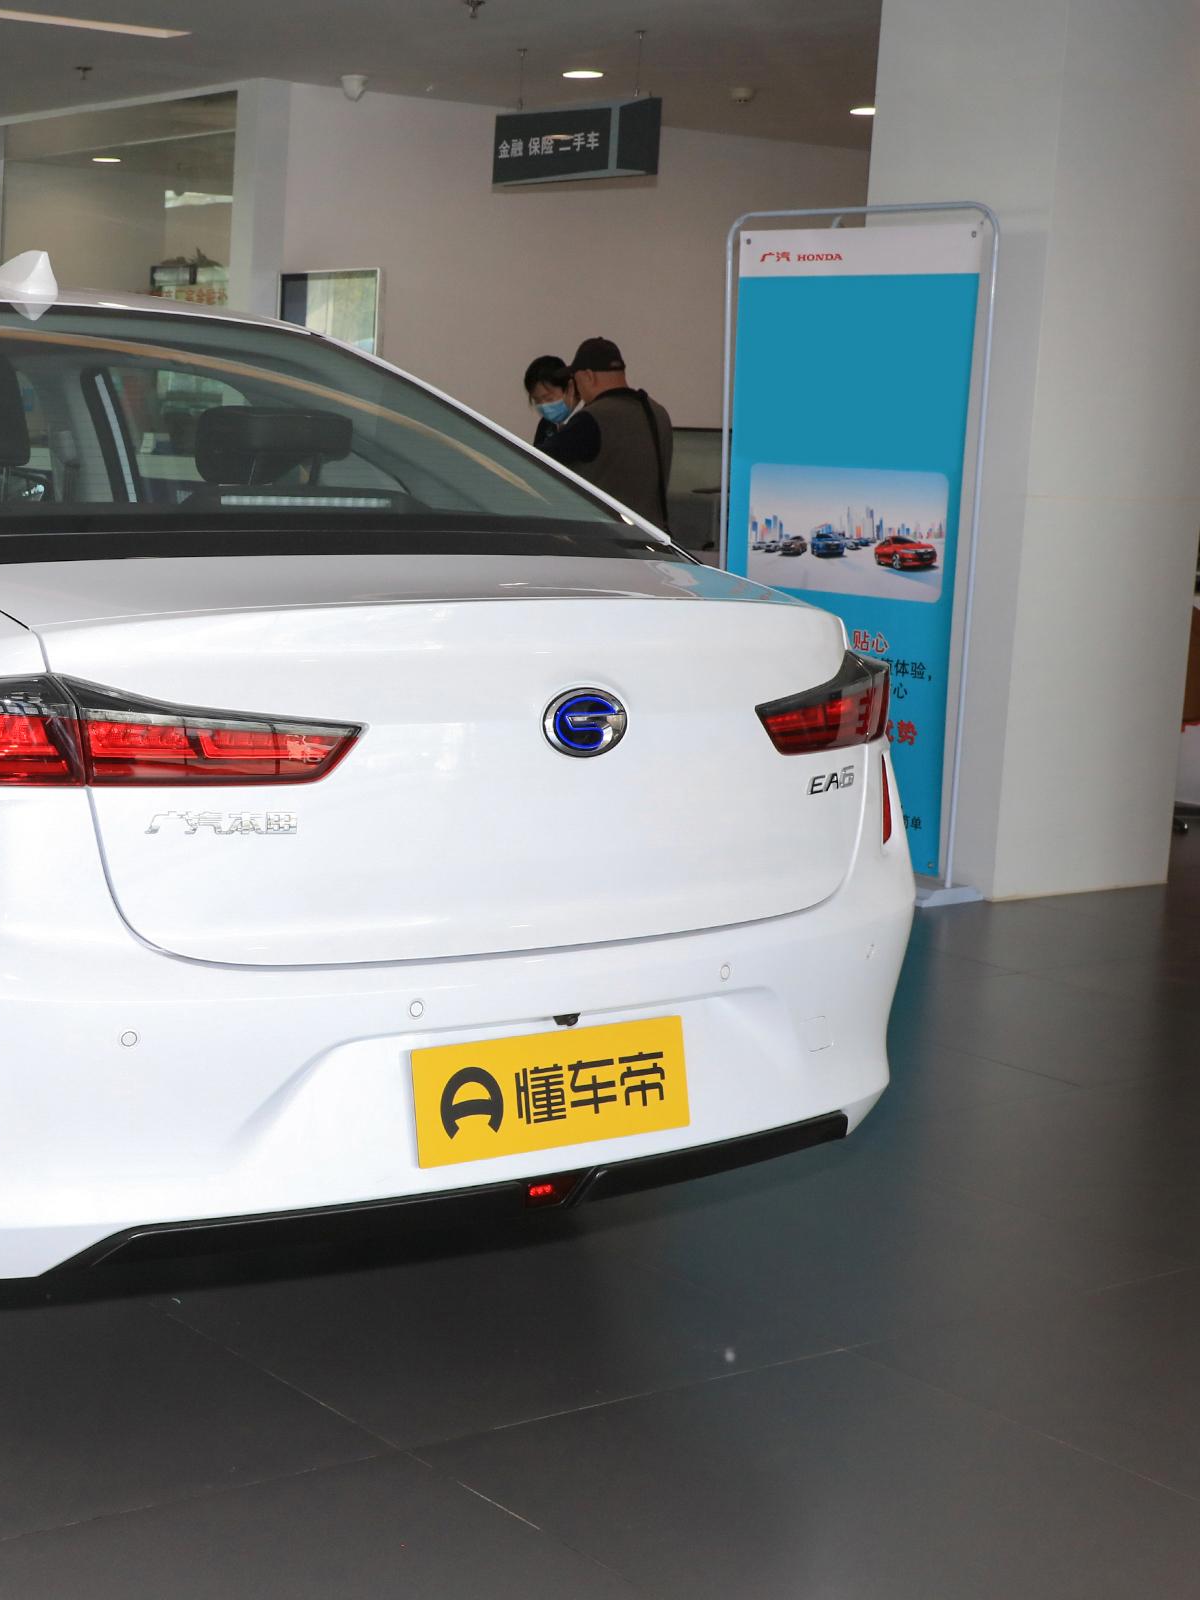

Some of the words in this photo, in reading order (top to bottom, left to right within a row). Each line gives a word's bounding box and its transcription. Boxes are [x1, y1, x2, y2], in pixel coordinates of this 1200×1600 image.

[498, 139, 523, 159] 金融
[528, 136, 554, 156] 保险
[760, 251, 790, 263] 广汽
[797, 253, 842, 262] HONDA
[853, 629, 889, 654] 贴心
[807, 765, 855, 795] EA6
[514, 1051, 666, 1125] 懂车帝
